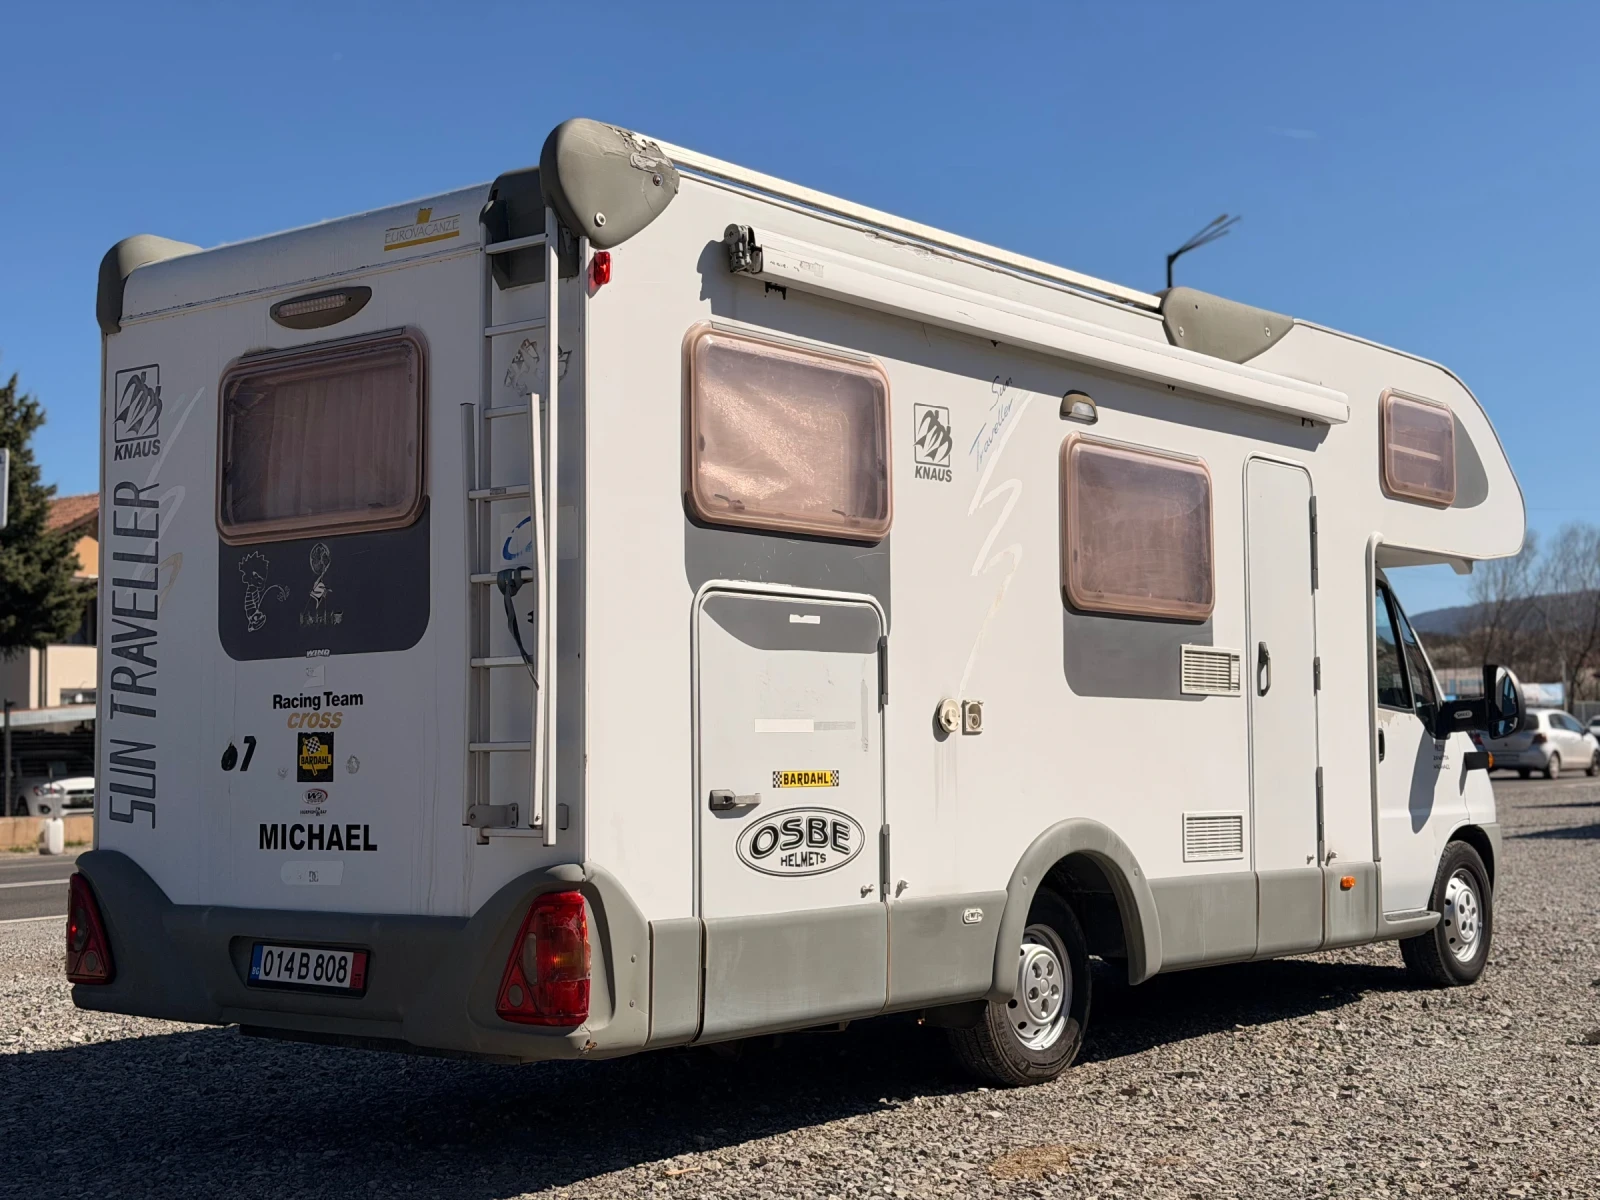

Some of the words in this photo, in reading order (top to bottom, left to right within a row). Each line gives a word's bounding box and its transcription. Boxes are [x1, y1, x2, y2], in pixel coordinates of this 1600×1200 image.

[384, 218, 460, 243] EUROVACANZE
[990, 375, 1012, 411] Sun
[969, 398, 1013, 472] Traveller
[114, 439, 161, 461] KNAUS
[914, 465, 953, 483] KNAUS
[109, 481, 160, 720] TRAVELLER
[305, 648, 331, 658] WIND
[273, 693, 321, 711] Racing
[323, 691, 364, 707] Team
[287, 712, 344, 729] cross
[300, 755, 331, 765] BARDAHL
[109, 738, 157, 829] SUN
[783, 772, 830, 786] BARDAHL
[259, 823, 378, 851] MICHAEL
[749, 815, 851, 860] OSBE
[780, 851, 827, 867] HELMETS
